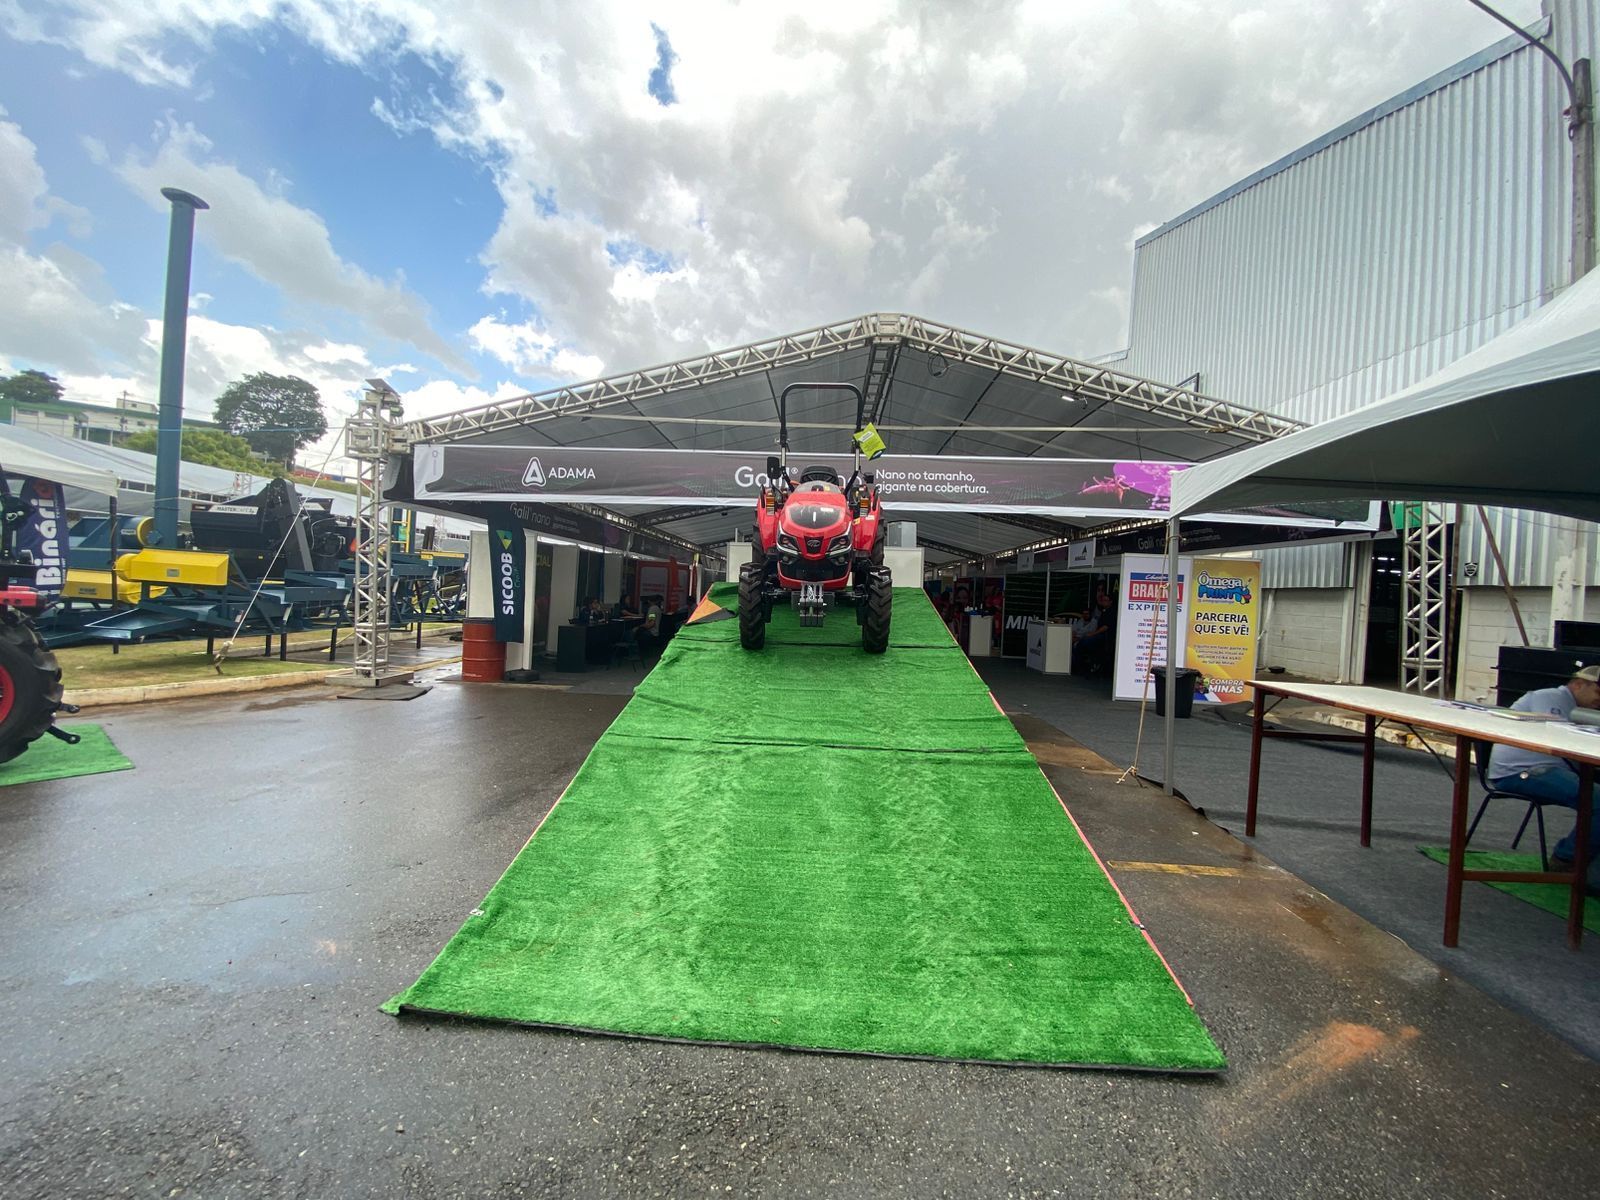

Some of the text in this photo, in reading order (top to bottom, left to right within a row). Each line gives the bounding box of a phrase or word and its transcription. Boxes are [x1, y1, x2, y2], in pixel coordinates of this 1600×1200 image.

[548, 467, 596, 479] ADAMA
[875, 469, 976, 483] Nano no tamanho,
[875, 481, 990, 494] gigante na cobertura.
[501, 552, 515, 616] SICOOB
[1199, 571, 1242, 588] Ômega
[1196, 612, 1249, 624] PARCERIA
[1194, 624, 1249, 636] QUE SE VÊ!
[1210, 678, 1245, 686] COMPRA
[1208, 685, 1244, 694] MINAS
